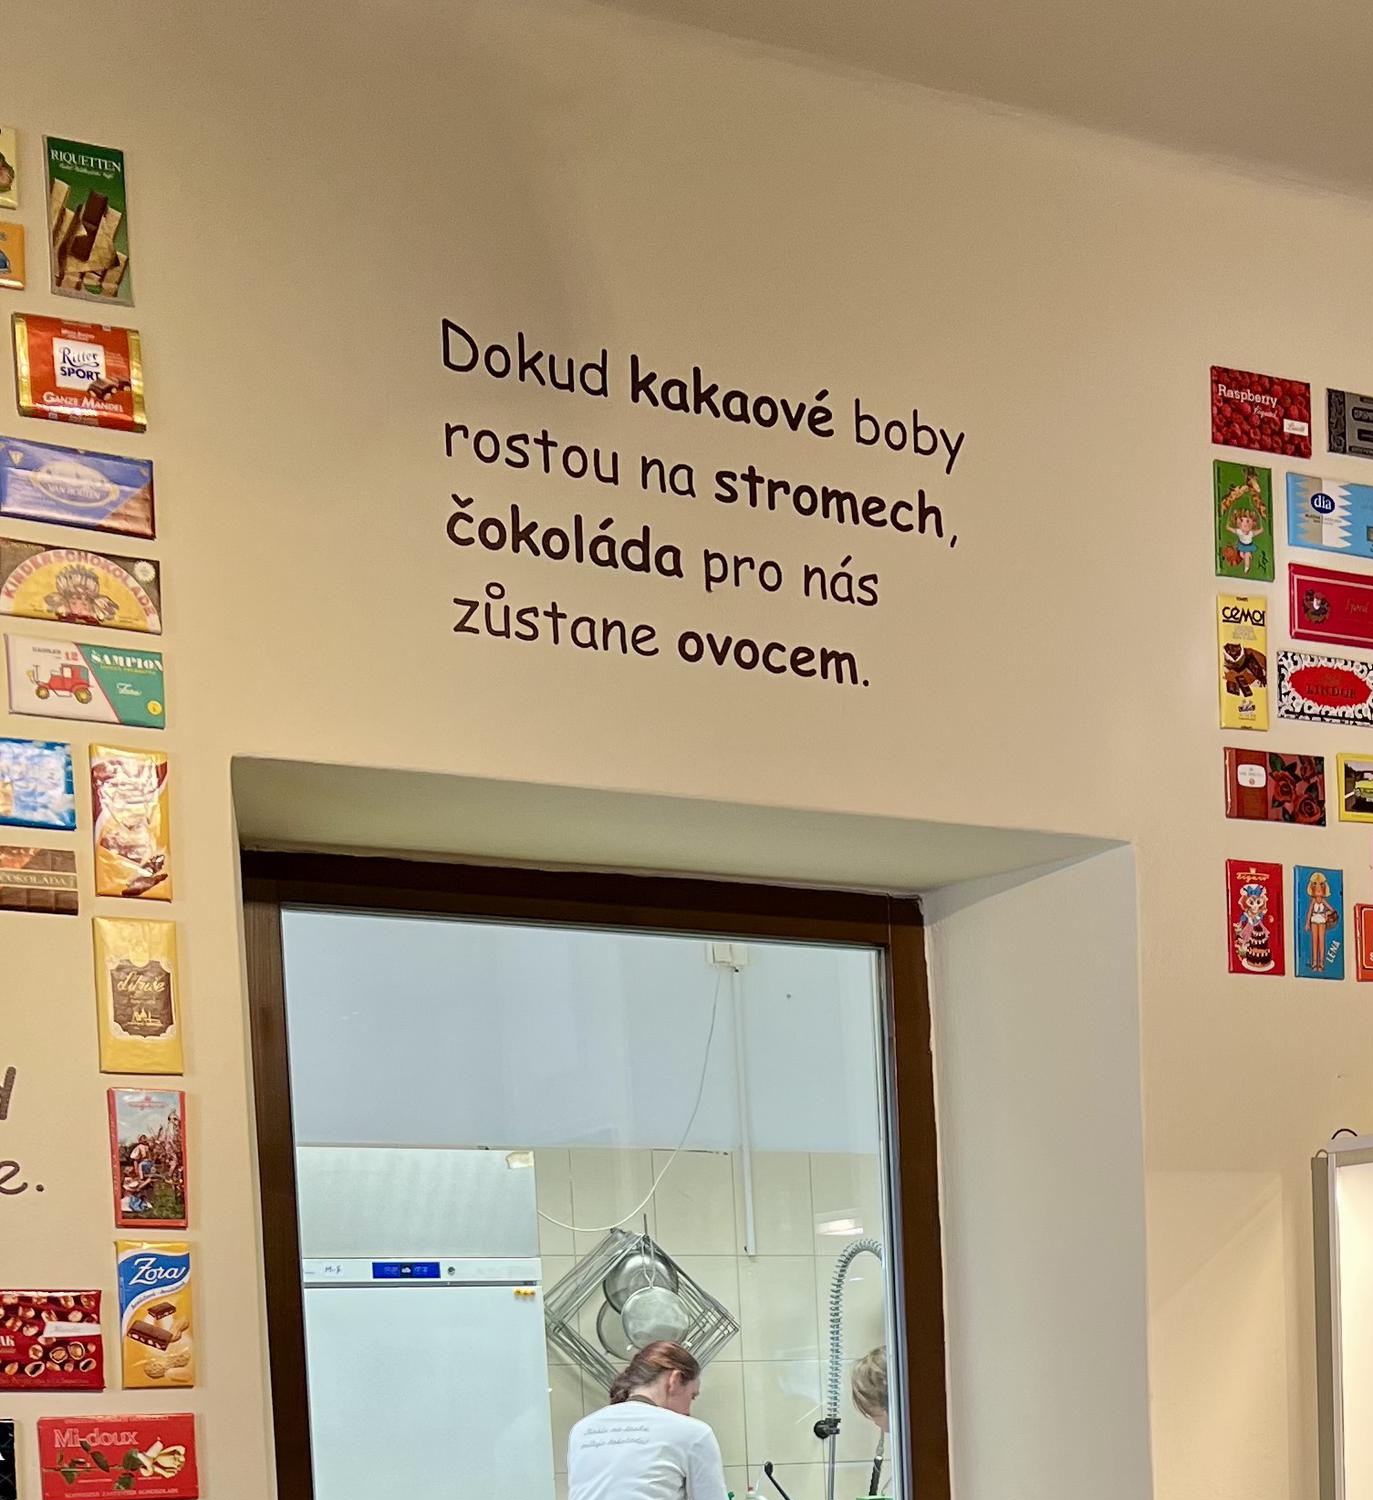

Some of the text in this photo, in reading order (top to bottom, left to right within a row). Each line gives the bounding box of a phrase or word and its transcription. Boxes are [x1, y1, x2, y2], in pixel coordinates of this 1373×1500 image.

[50, 149, 122, 173] RIQUETTEN
[59, 346, 100, 367] Ritter
[60, 365, 101, 381] SPORT
[441, 318, 965, 474] Dokud kakaové boby
[1218, 383, 1278, 408] Raspberry
[444, 422, 958, 548] rostou na stromech,
[1313, 494, 1332, 511] dia
[447, 494, 879, 607] čokoláda pro nás
[452, 581, 869, 687] zůstane ovocem.
[1326, 939, 1341, 963] LENA
[129, 1257, 187, 1286] Zora
[53, 1428, 139, 1449] Mi-doux
